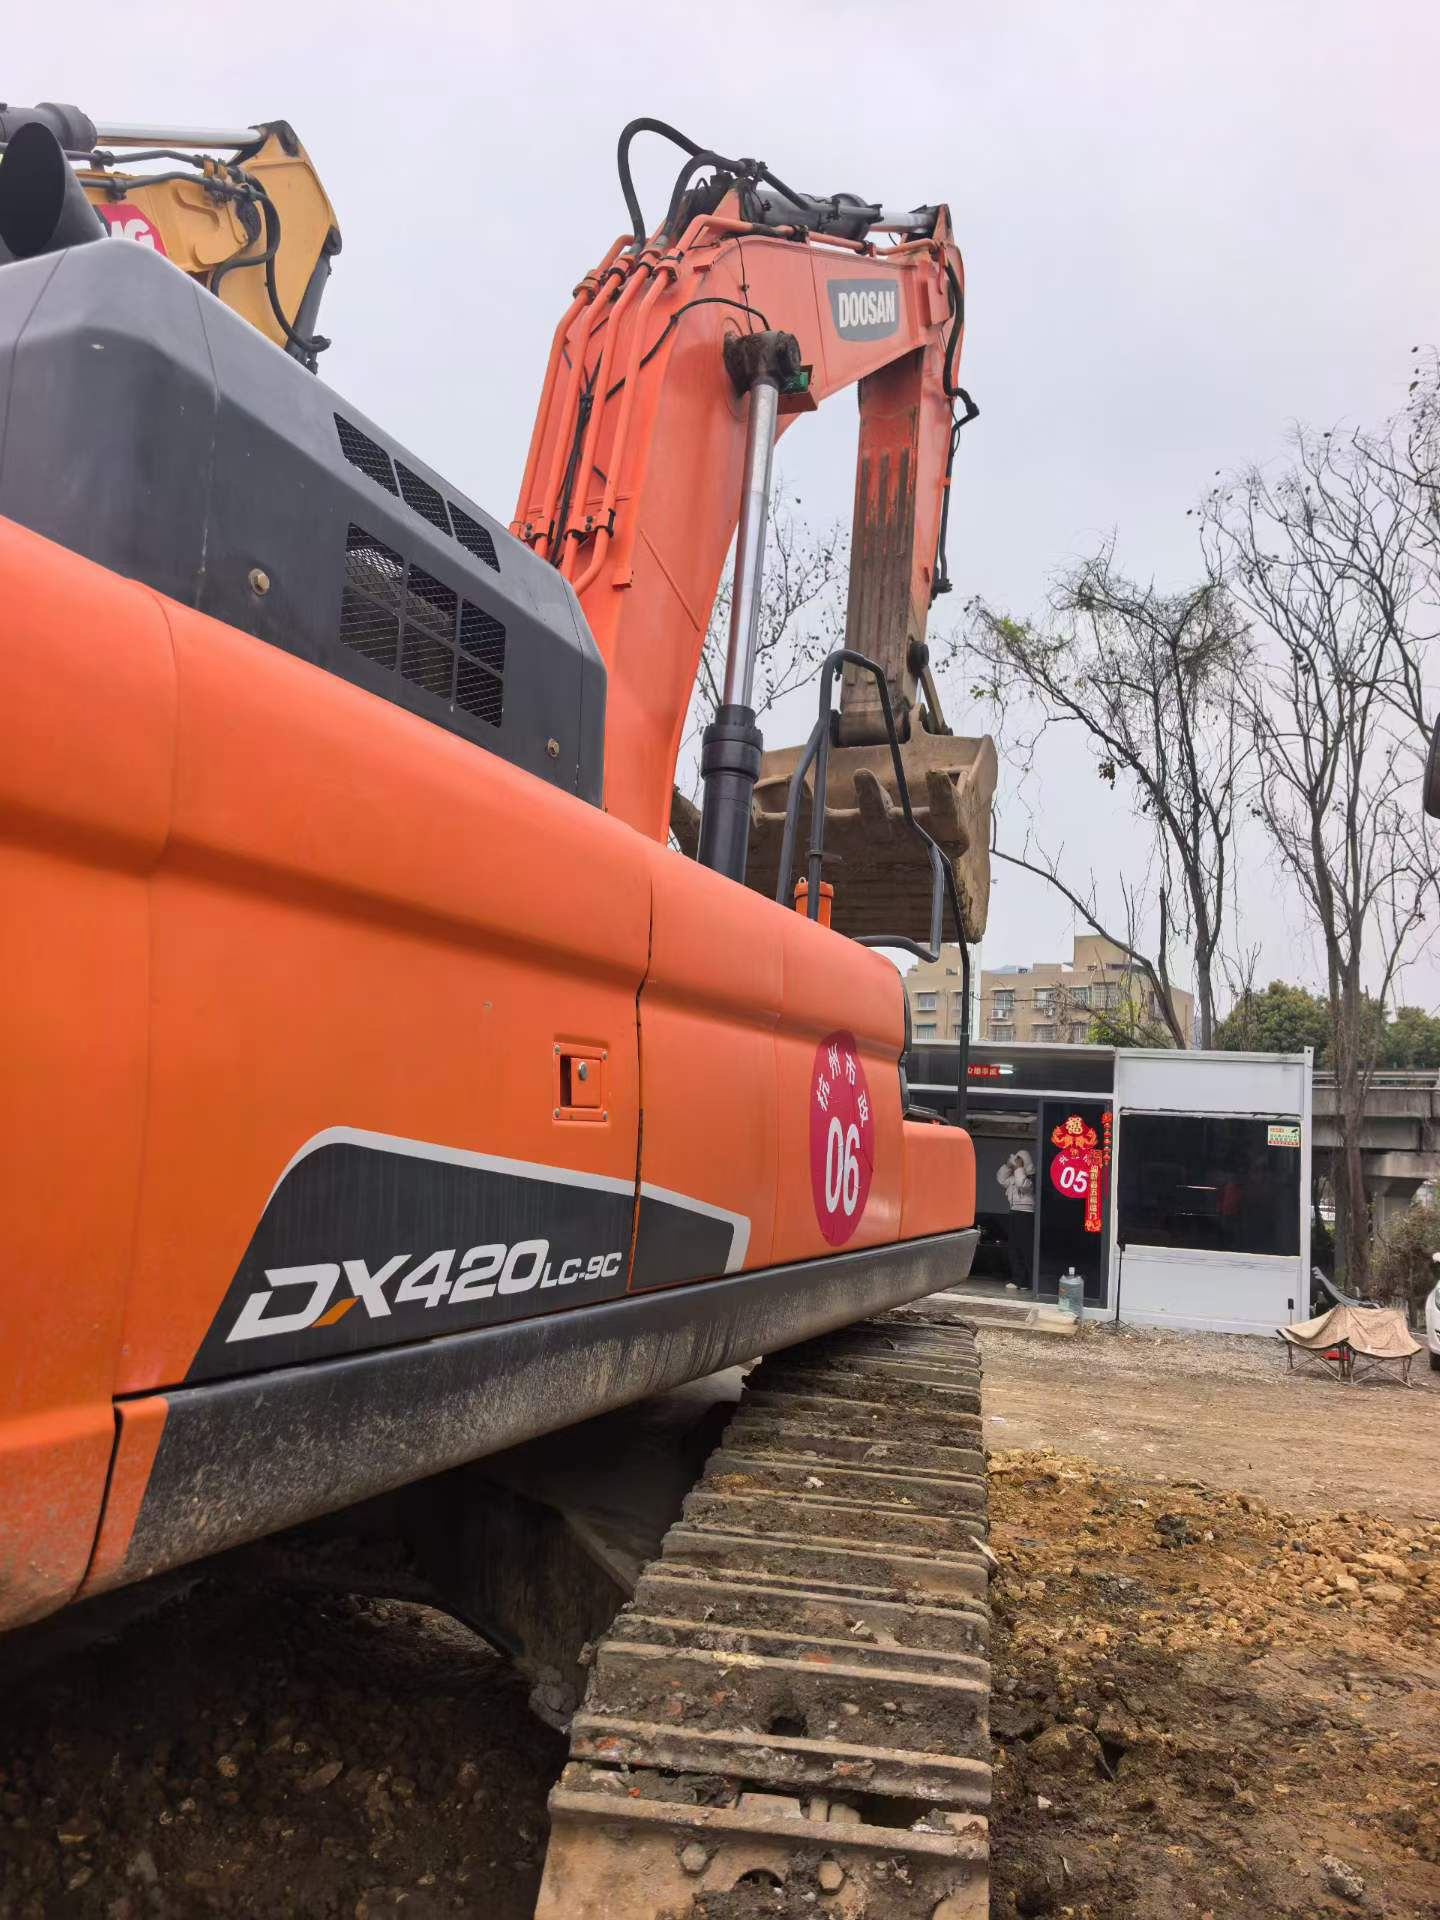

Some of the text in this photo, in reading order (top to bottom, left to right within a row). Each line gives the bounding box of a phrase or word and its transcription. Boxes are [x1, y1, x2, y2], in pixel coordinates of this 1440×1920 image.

[838, 290, 896, 328] DOOSAN
[816, 1042, 869, 1128] 杭州市政
[825, 1116, 861, 1216] 06
[1060, 1166, 1089, 1193] 05
